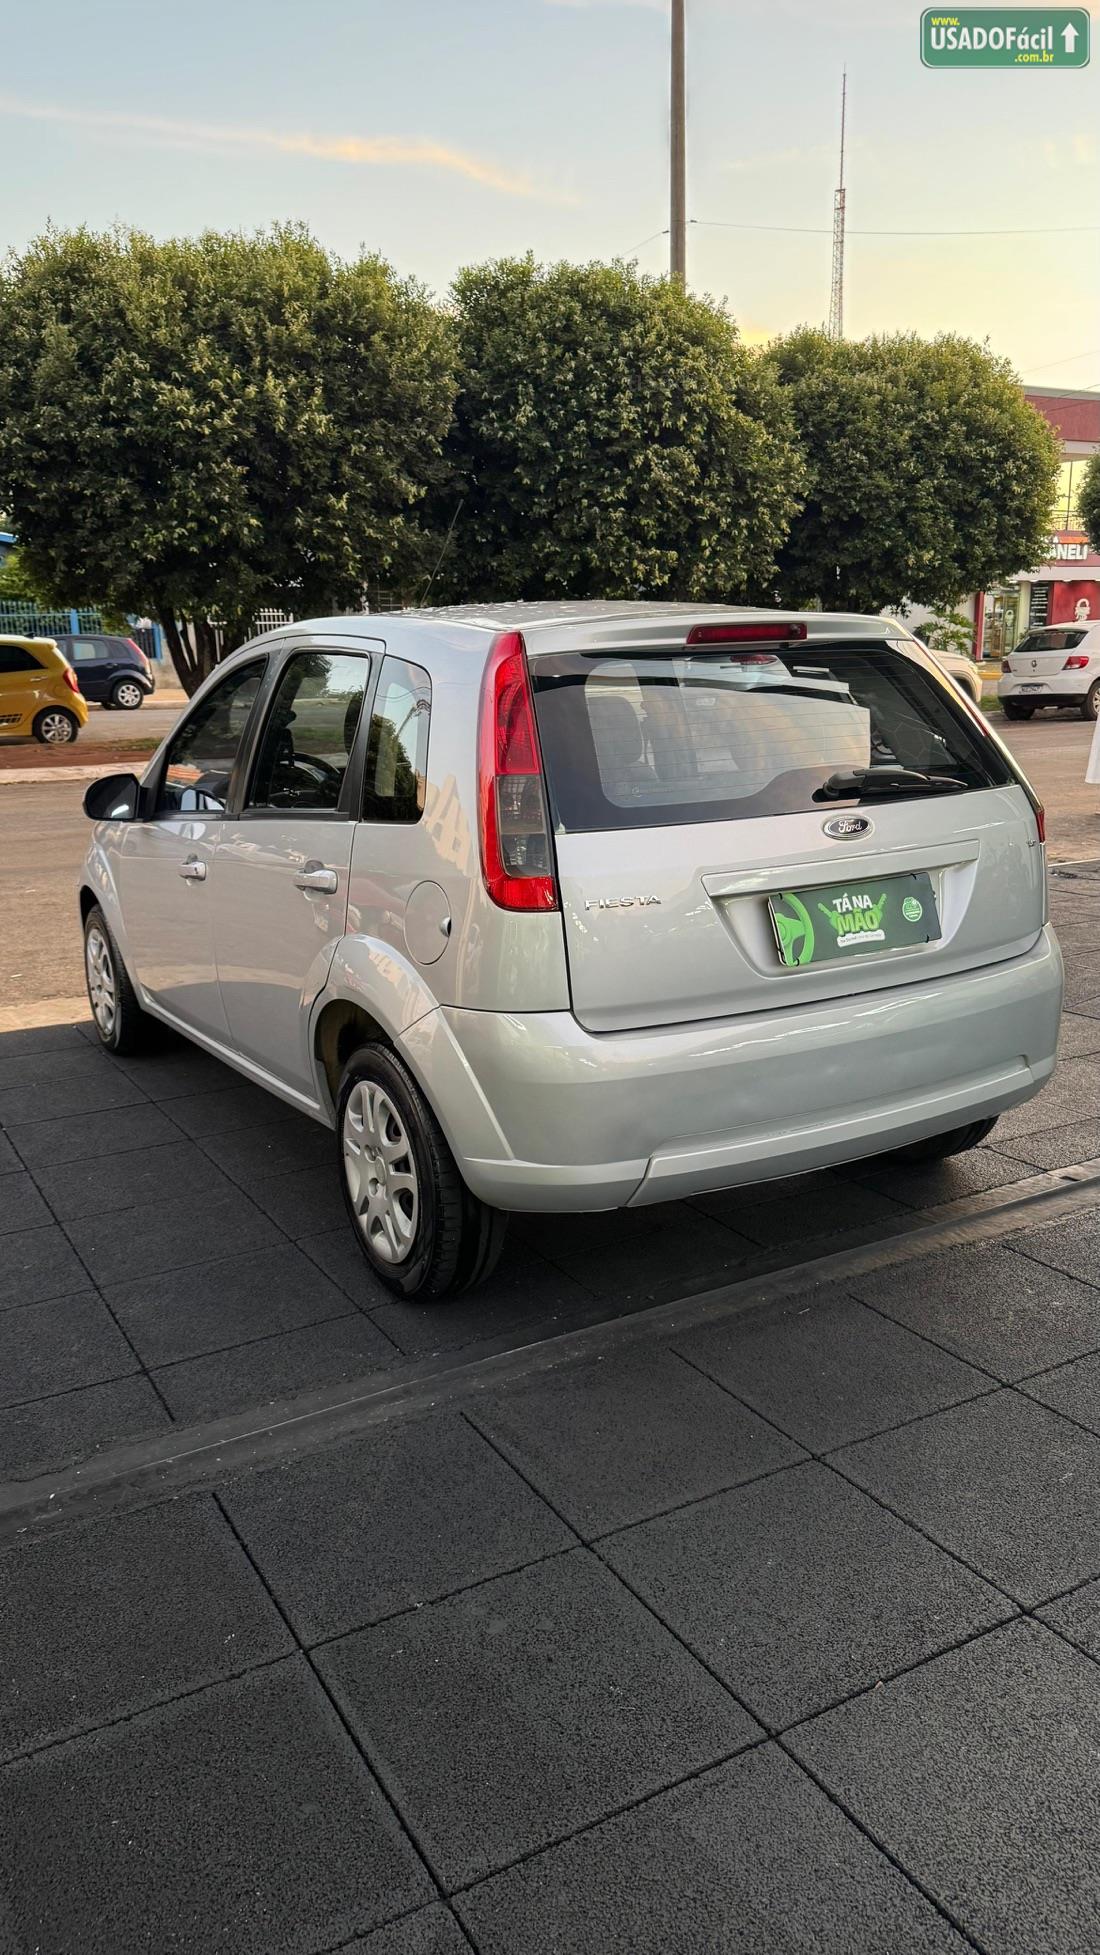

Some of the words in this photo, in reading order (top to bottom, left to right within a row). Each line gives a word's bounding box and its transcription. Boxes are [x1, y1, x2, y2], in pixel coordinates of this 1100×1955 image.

[838, 820, 863, 833] Ford
[584, 895, 662, 911] FIESTA
[832, 893, 853, 913] TÁ
[852, 894, 873, 909] NA
[836, 909, 880, 936] MÃO
